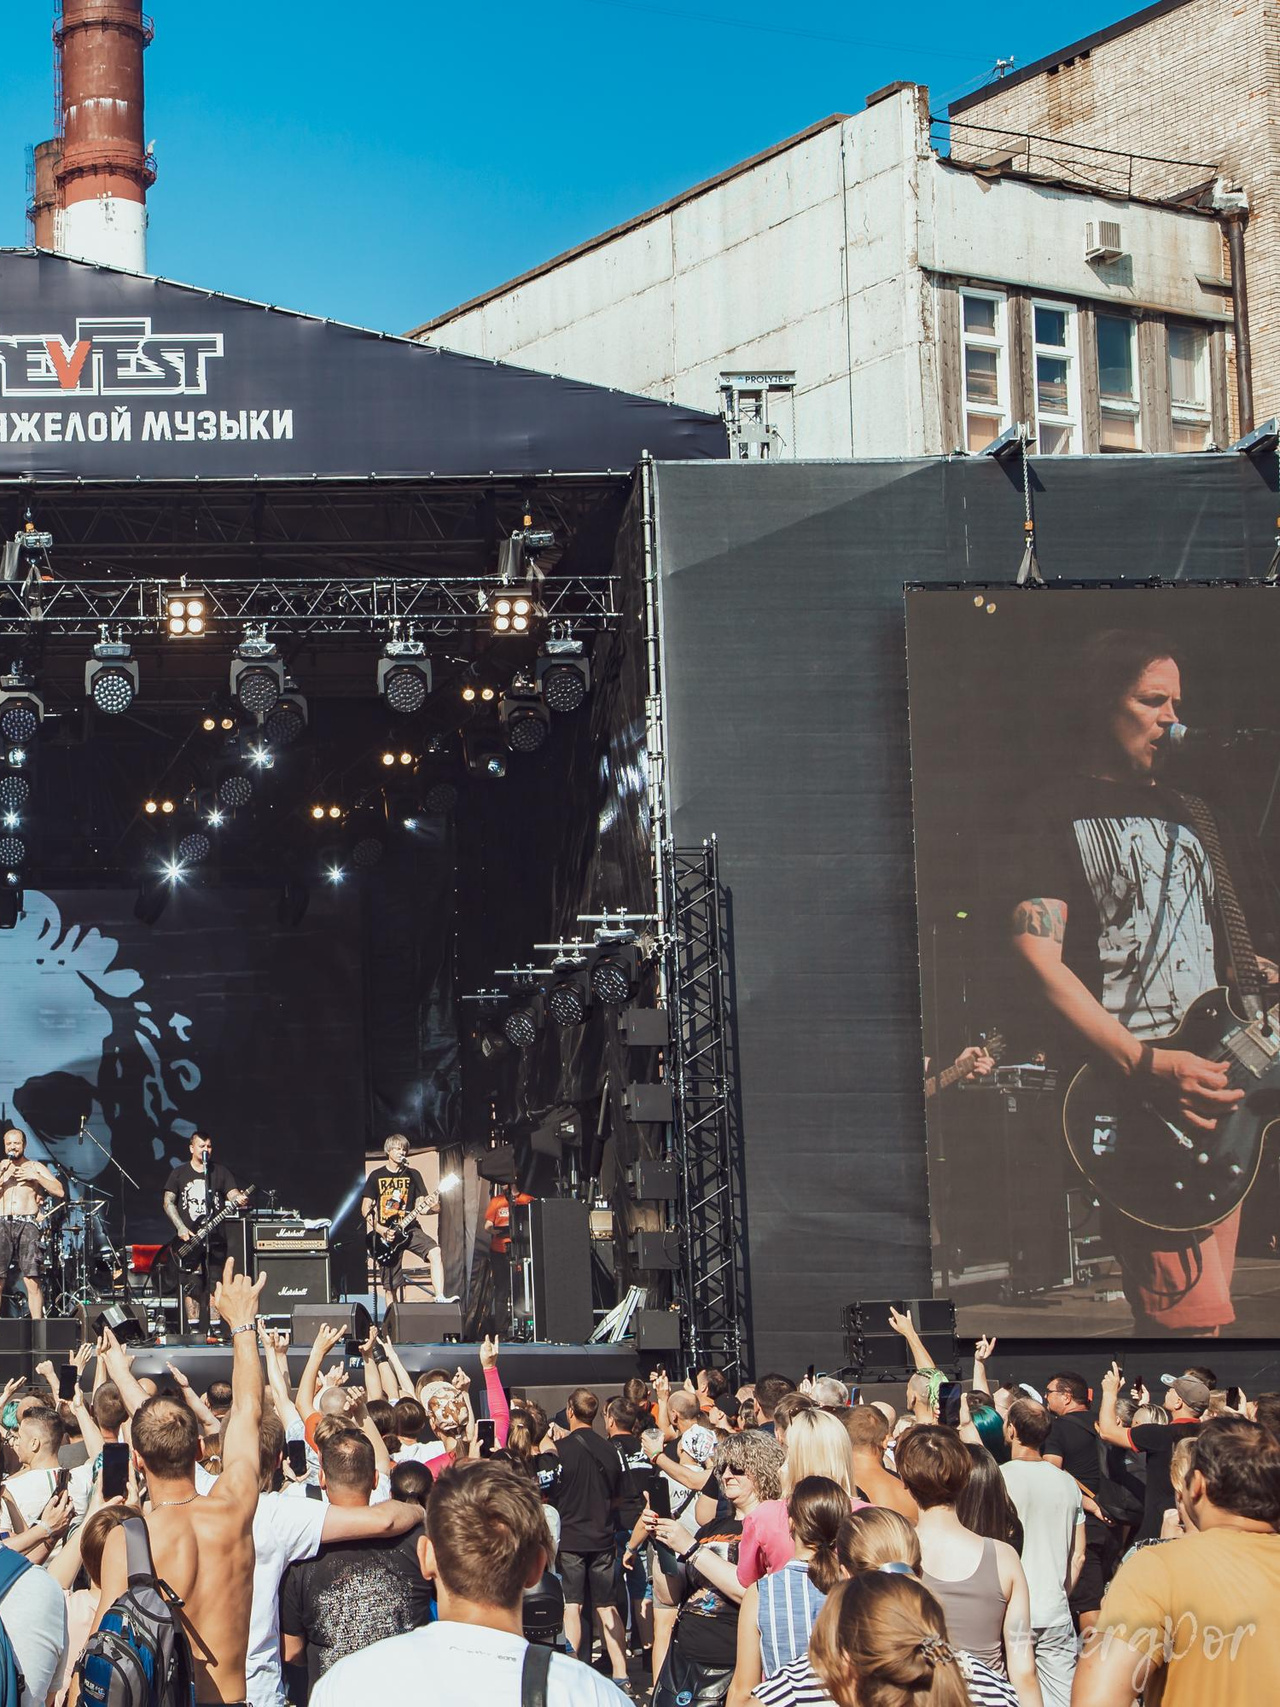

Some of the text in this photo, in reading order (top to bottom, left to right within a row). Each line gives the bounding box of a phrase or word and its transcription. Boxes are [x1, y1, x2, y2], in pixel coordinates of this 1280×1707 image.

[745, 375, 784, 384] PROLYTE
[141, 409, 294, 442] МУЗЫКИ
[381, 1179, 410, 1190] RAGE
[275, 1228, 306, 1237] Marshall
[277, 1286, 308, 1296] Marshall
